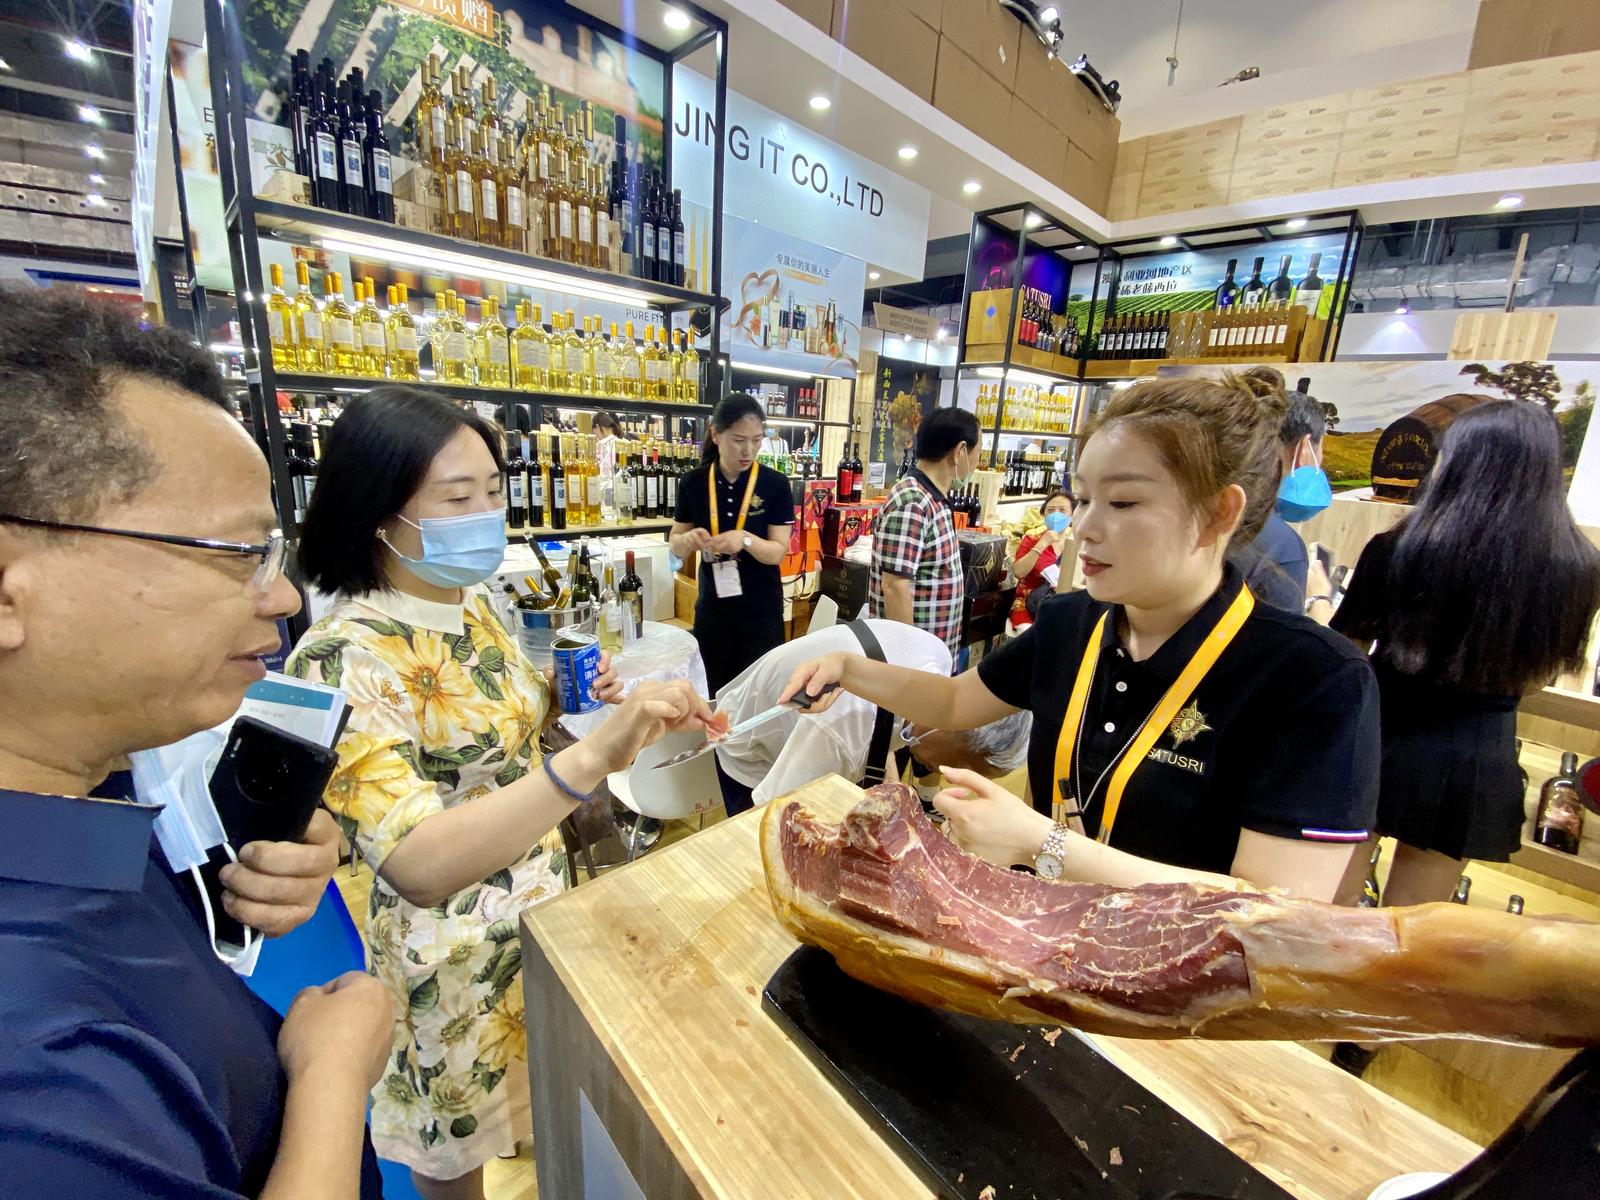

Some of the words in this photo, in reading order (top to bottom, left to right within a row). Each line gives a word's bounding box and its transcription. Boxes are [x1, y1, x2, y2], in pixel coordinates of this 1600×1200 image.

[759, 136, 785, 175] IT
[791, 153, 884, 217] CO.,LTD
[776, 253, 831, 279] 专属你的美丽人生
[1101, 264, 1193, 285] 澳利亚河地产区
[1116, 279, 1177, 296] 稀老藤西拉
[625, 308, 649, 322] PURE
[1146, 747, 1205, 773] SATUSRI
